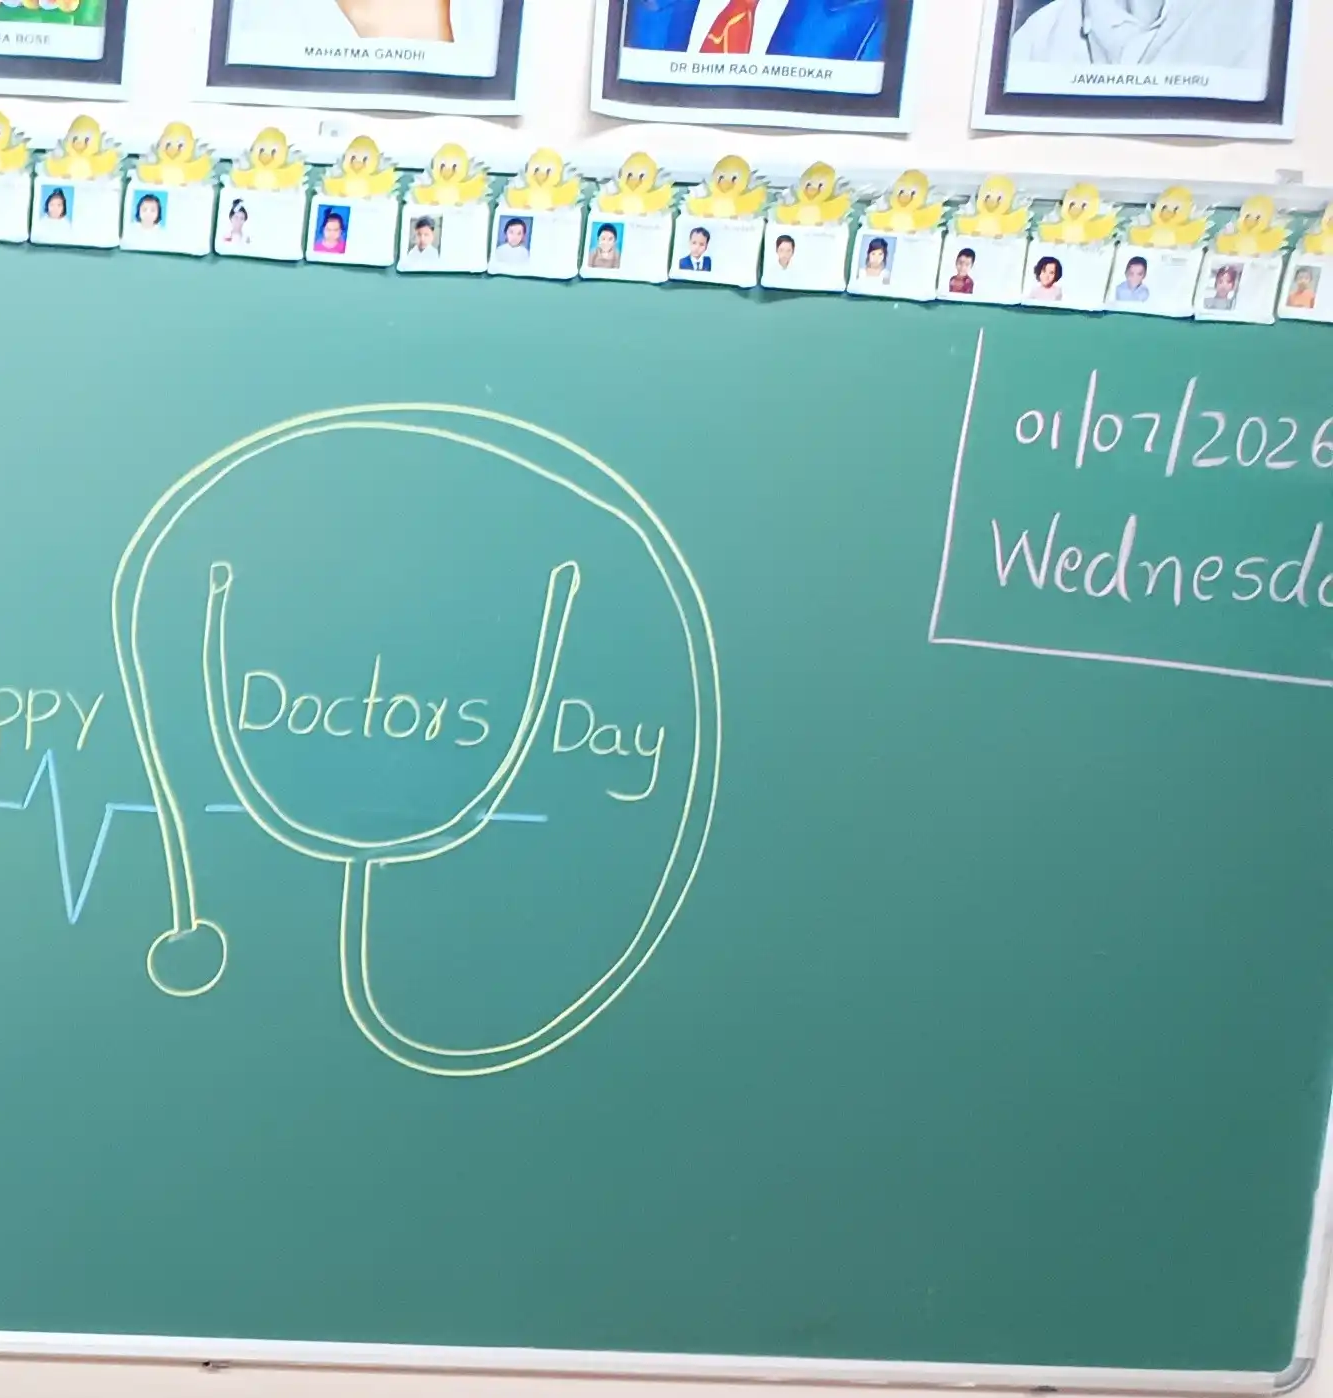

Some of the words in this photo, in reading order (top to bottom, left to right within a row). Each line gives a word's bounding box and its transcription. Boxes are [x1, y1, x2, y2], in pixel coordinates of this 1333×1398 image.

[16, 33, 51, 46] BOSE
[304, 46, 370, 59] MAHATMA
[374, 48, 426, 61] GANDHI
[669, 61, 687, 73] DR
[692, 63, 725, 75] BHIM
[729, 64, 758, 76] RAO
[761, 66, 833, 80] AMBEDKAR
[1070, 73, 1159, 86] JAWAHARLAL
[1164, 75, 1209, 87] NEHRU
[1015, 369, 1333, 477] 01/07/2026
[237, 655, 491, 749] Doctors
[553, 699, 665, 801] Day
